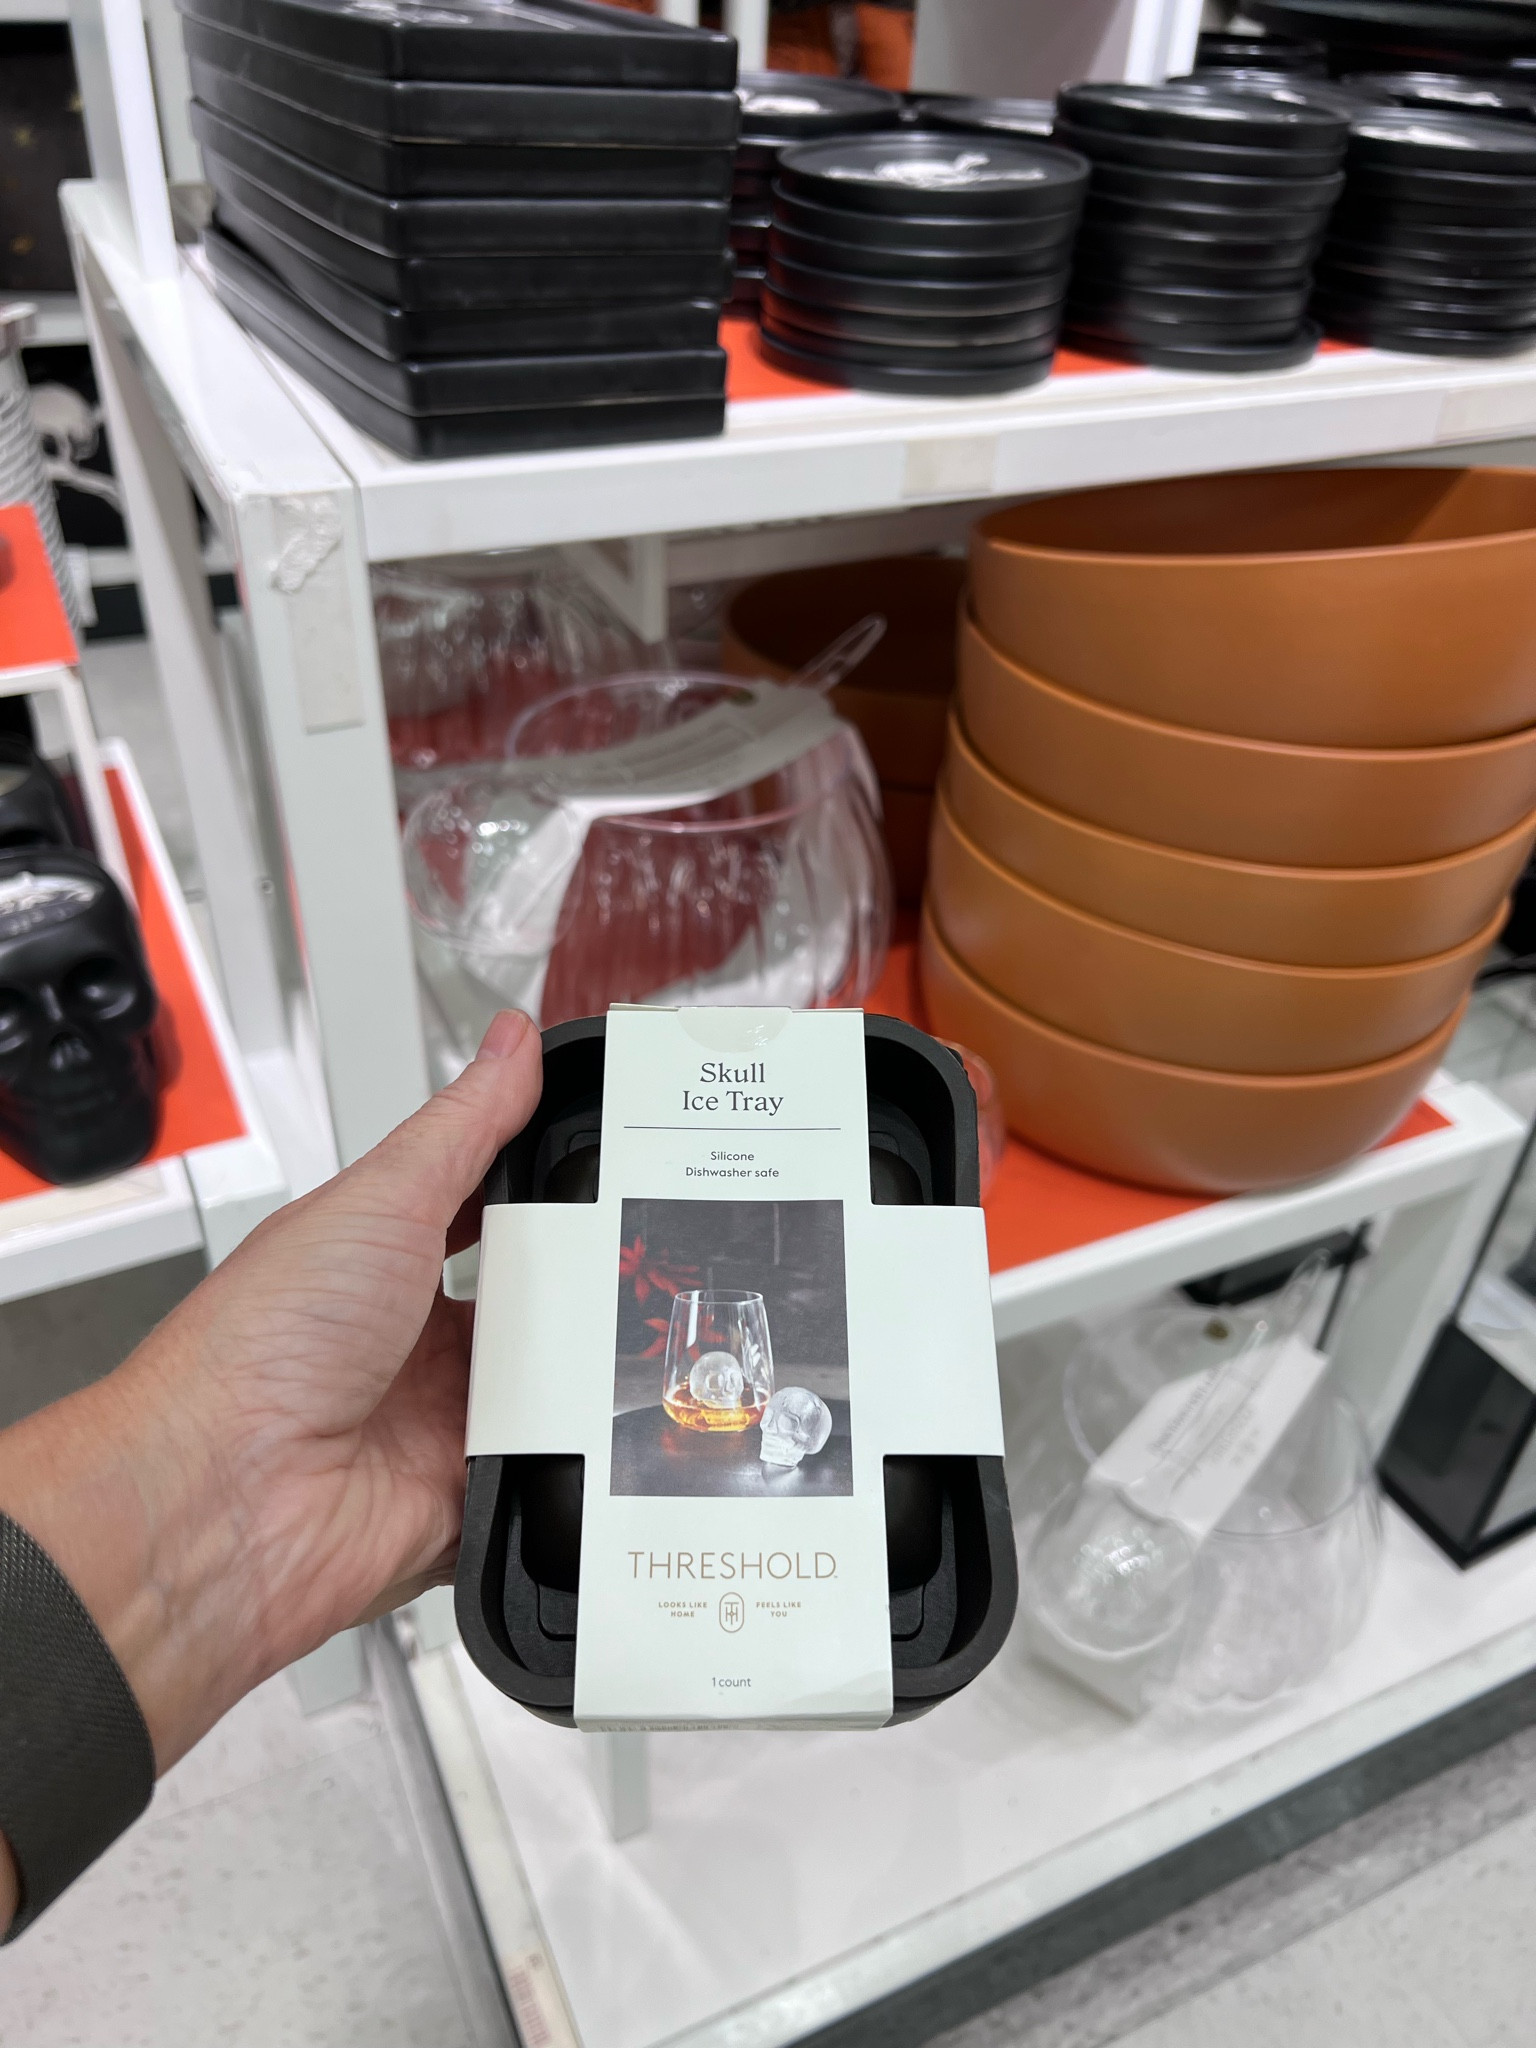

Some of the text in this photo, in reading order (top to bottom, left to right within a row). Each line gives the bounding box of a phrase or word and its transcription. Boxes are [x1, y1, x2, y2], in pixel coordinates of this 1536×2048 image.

[700, 1062, 765, 1083] Skull
[683, 1090, 784, 1116] Ice Tray
[710, 1151, 755, 1161] Silicone
[685, 1167, 780, 1178] Dishwasher safe
[627, 1551, 838, 1580] THRESHOLD
[711, 1676, 752, 1688] 1 count
